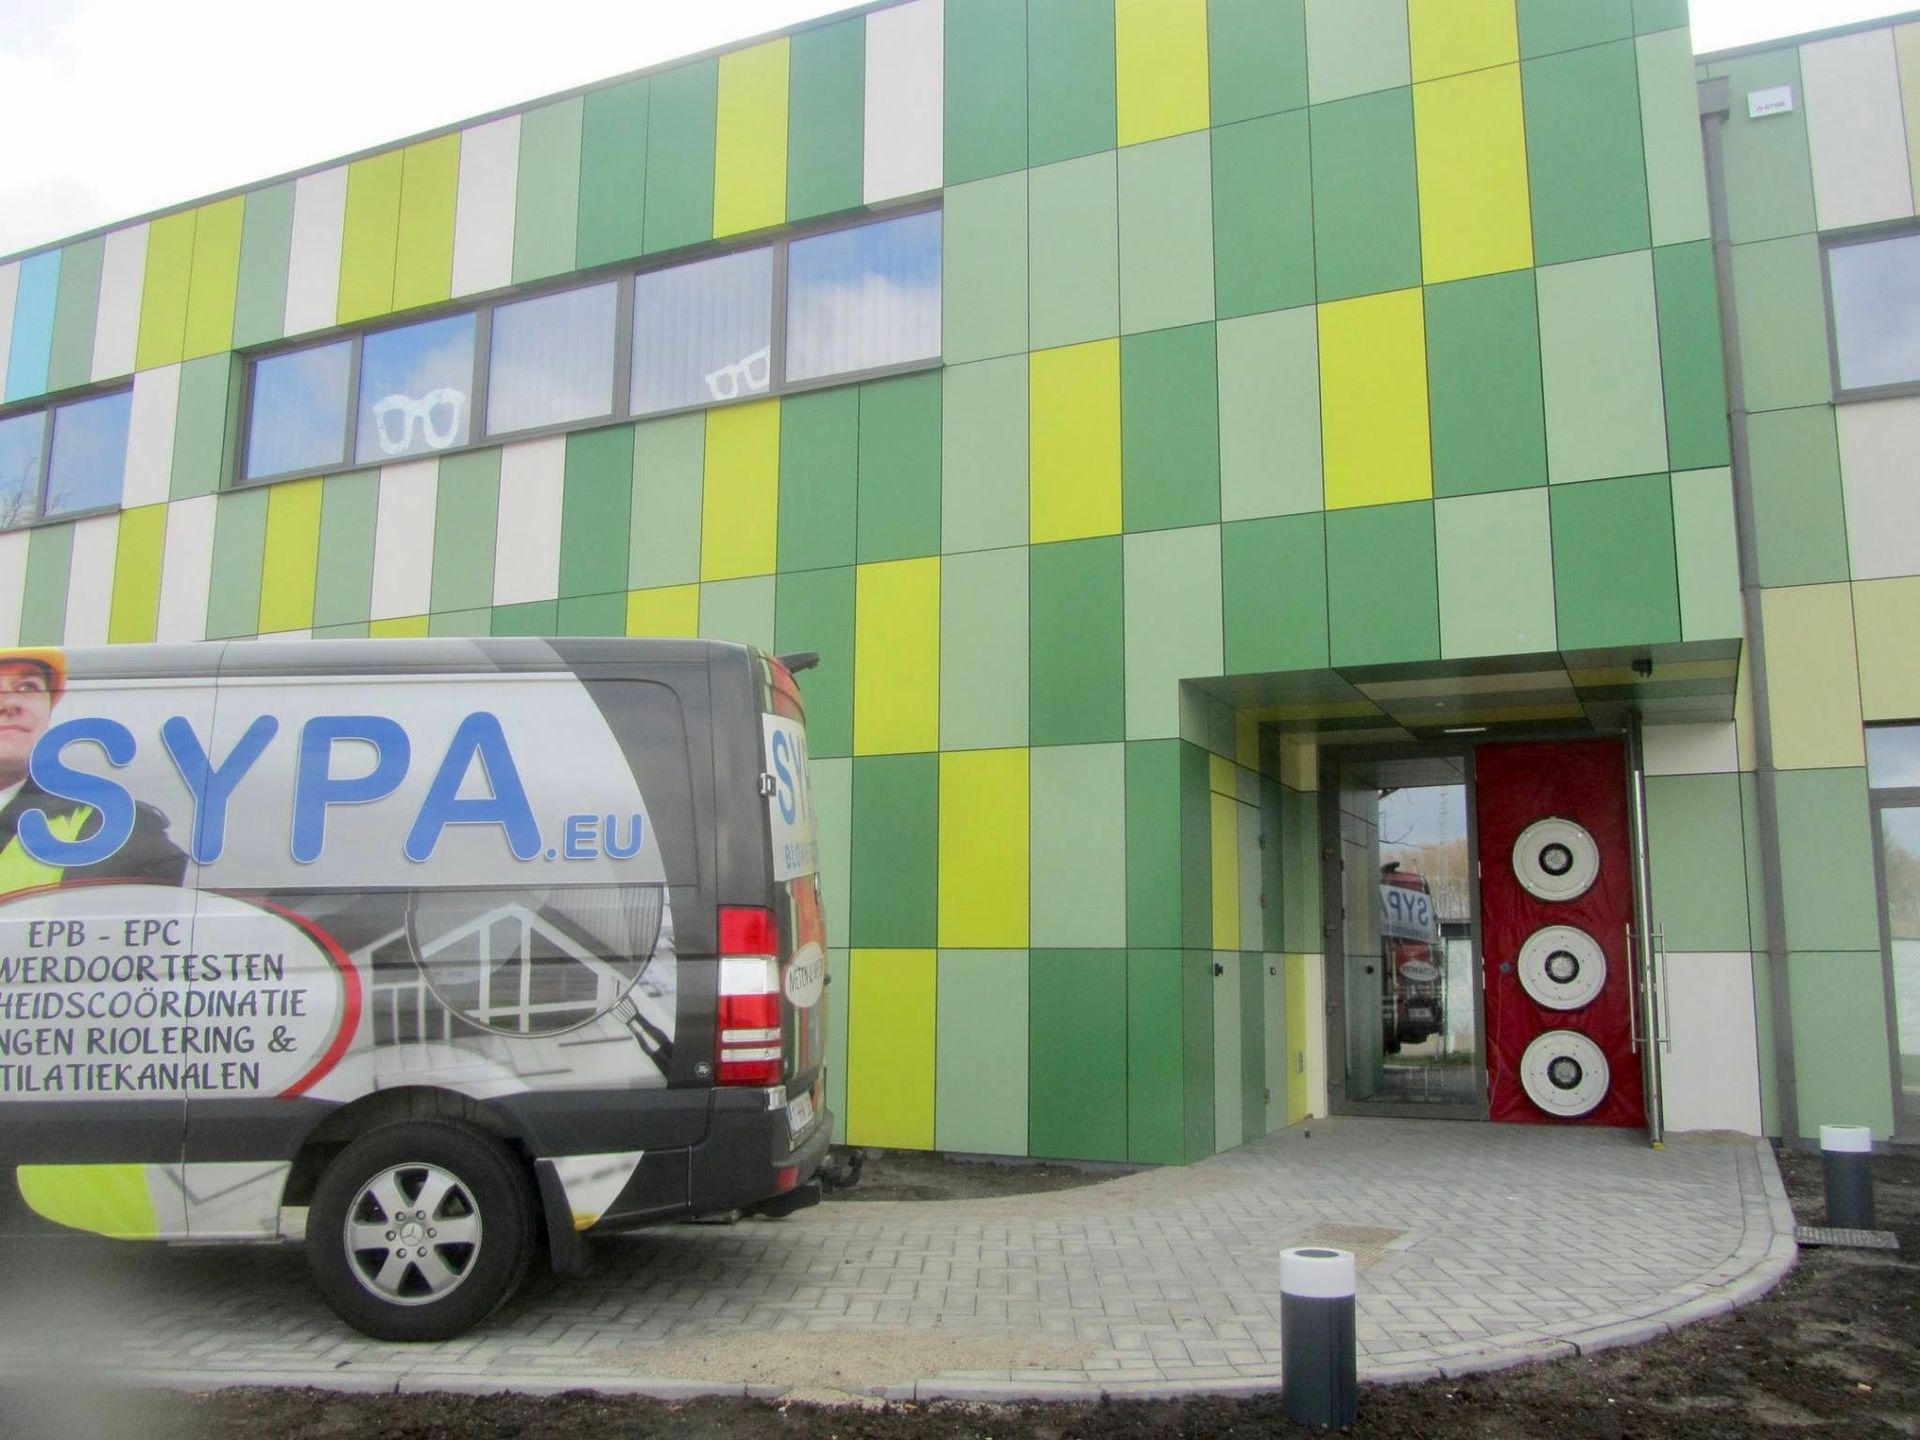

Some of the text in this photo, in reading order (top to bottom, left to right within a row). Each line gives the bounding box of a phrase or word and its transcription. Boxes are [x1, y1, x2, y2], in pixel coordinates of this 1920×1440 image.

[29, 920, 85, 948] EPB
[125, 919, 181, 947] EPC
[0, 953, 284, 984] WERDOORTESTEN
[0, 987, 308, 1020] HEIDSCOÖRDINATIE
[87, 1025, 255, 1055] RIOLERING
[268, 1025, 298, 1053] &
[0, 1062, 260, 1092] TILATIEKANALEN
